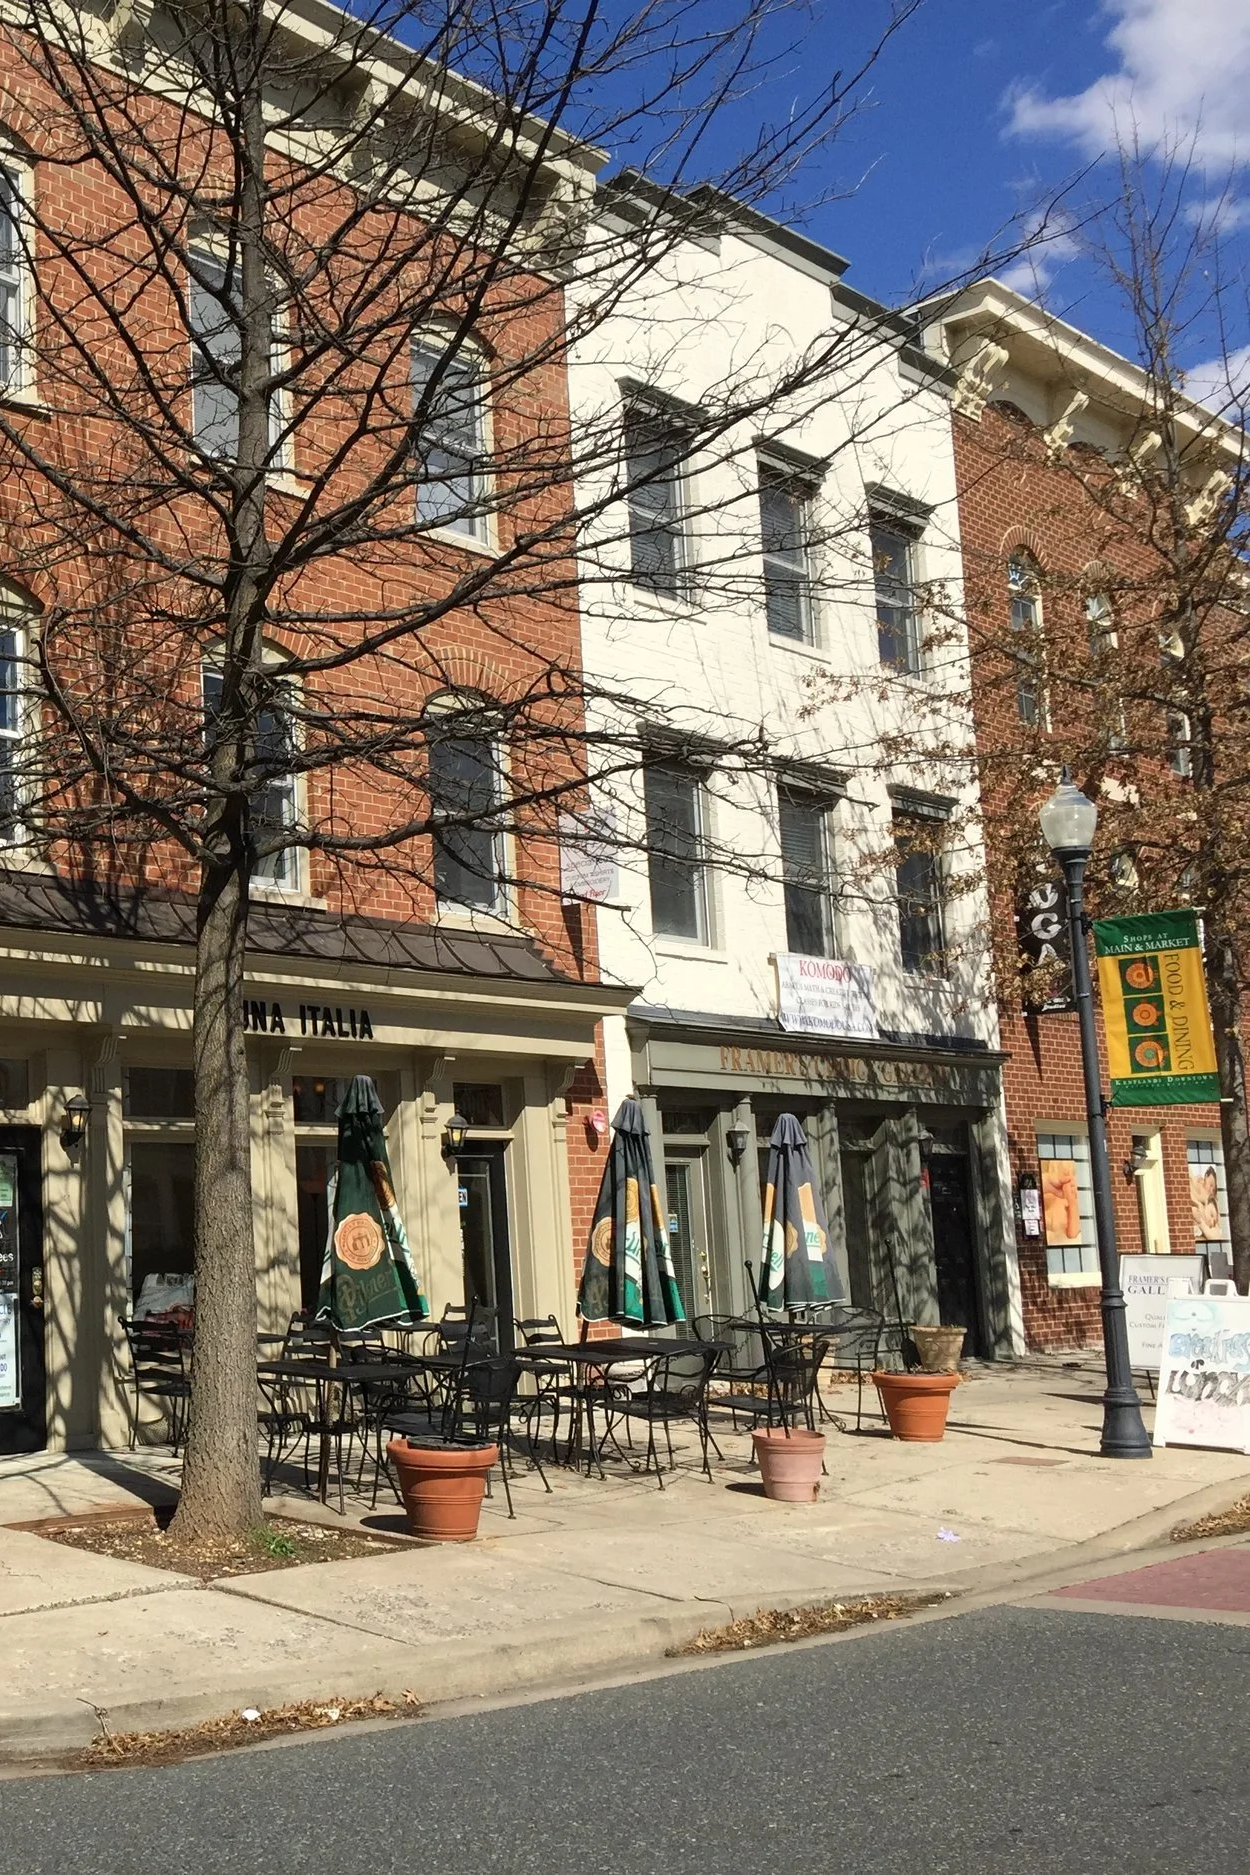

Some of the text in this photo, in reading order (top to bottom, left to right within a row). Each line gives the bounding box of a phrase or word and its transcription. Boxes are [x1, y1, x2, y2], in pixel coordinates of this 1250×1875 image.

[1105, 936, 1191, 955] MAIN & MARKET
[798, 959, 852, 984] KOMODO
[300, 1004, 374, 1040] ITALIA
[1163, 952, 1195, 1071] FOOD & DINING
